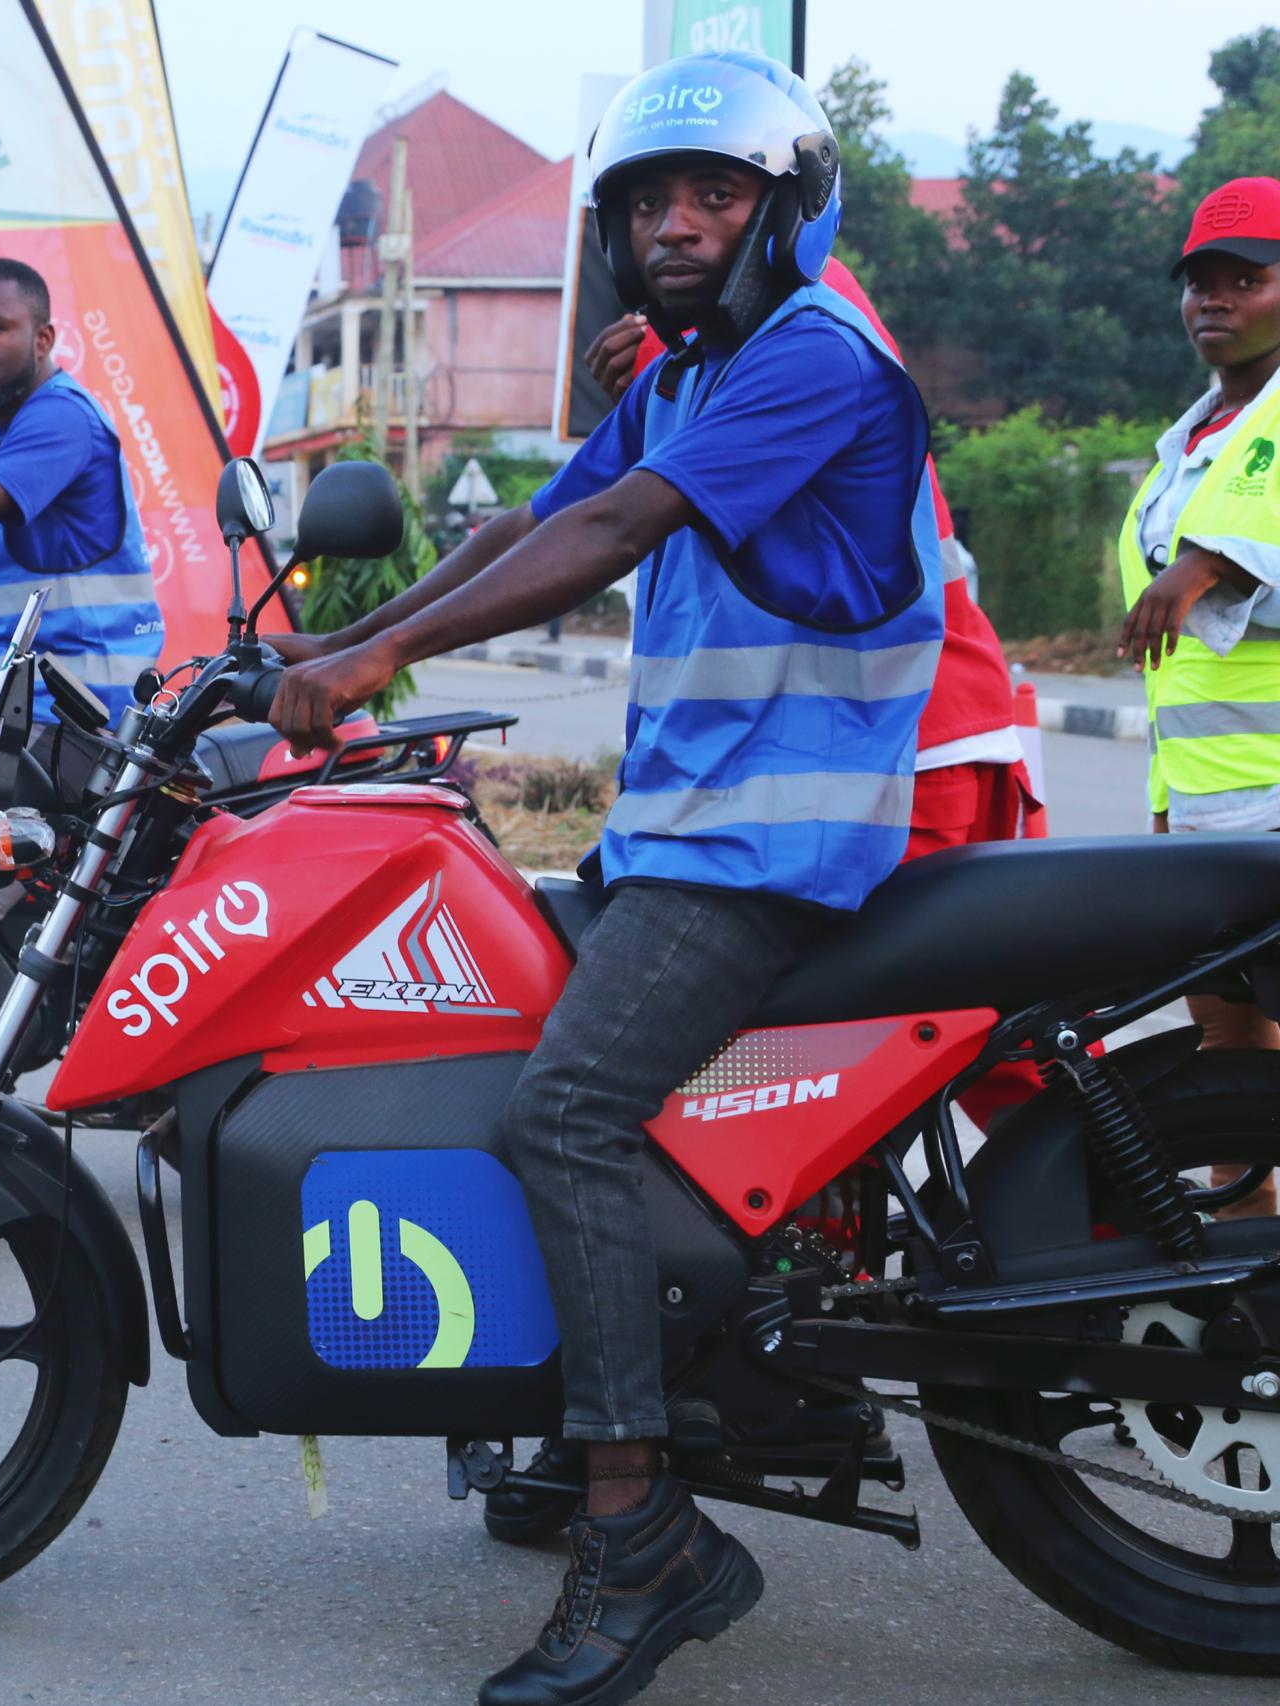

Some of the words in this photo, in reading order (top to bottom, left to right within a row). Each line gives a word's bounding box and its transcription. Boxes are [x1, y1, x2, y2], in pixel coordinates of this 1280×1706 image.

[624, 85, 722, 122] spiro
[650, 120, 664, 130] on
[666, 118, 684, 127] the
[685, 117, 718, 126] move
[106, 880, 269, 1037] spiro
[337, 978, 477, 1003] EKON
[682, 1073, 839, 1121] 450M
